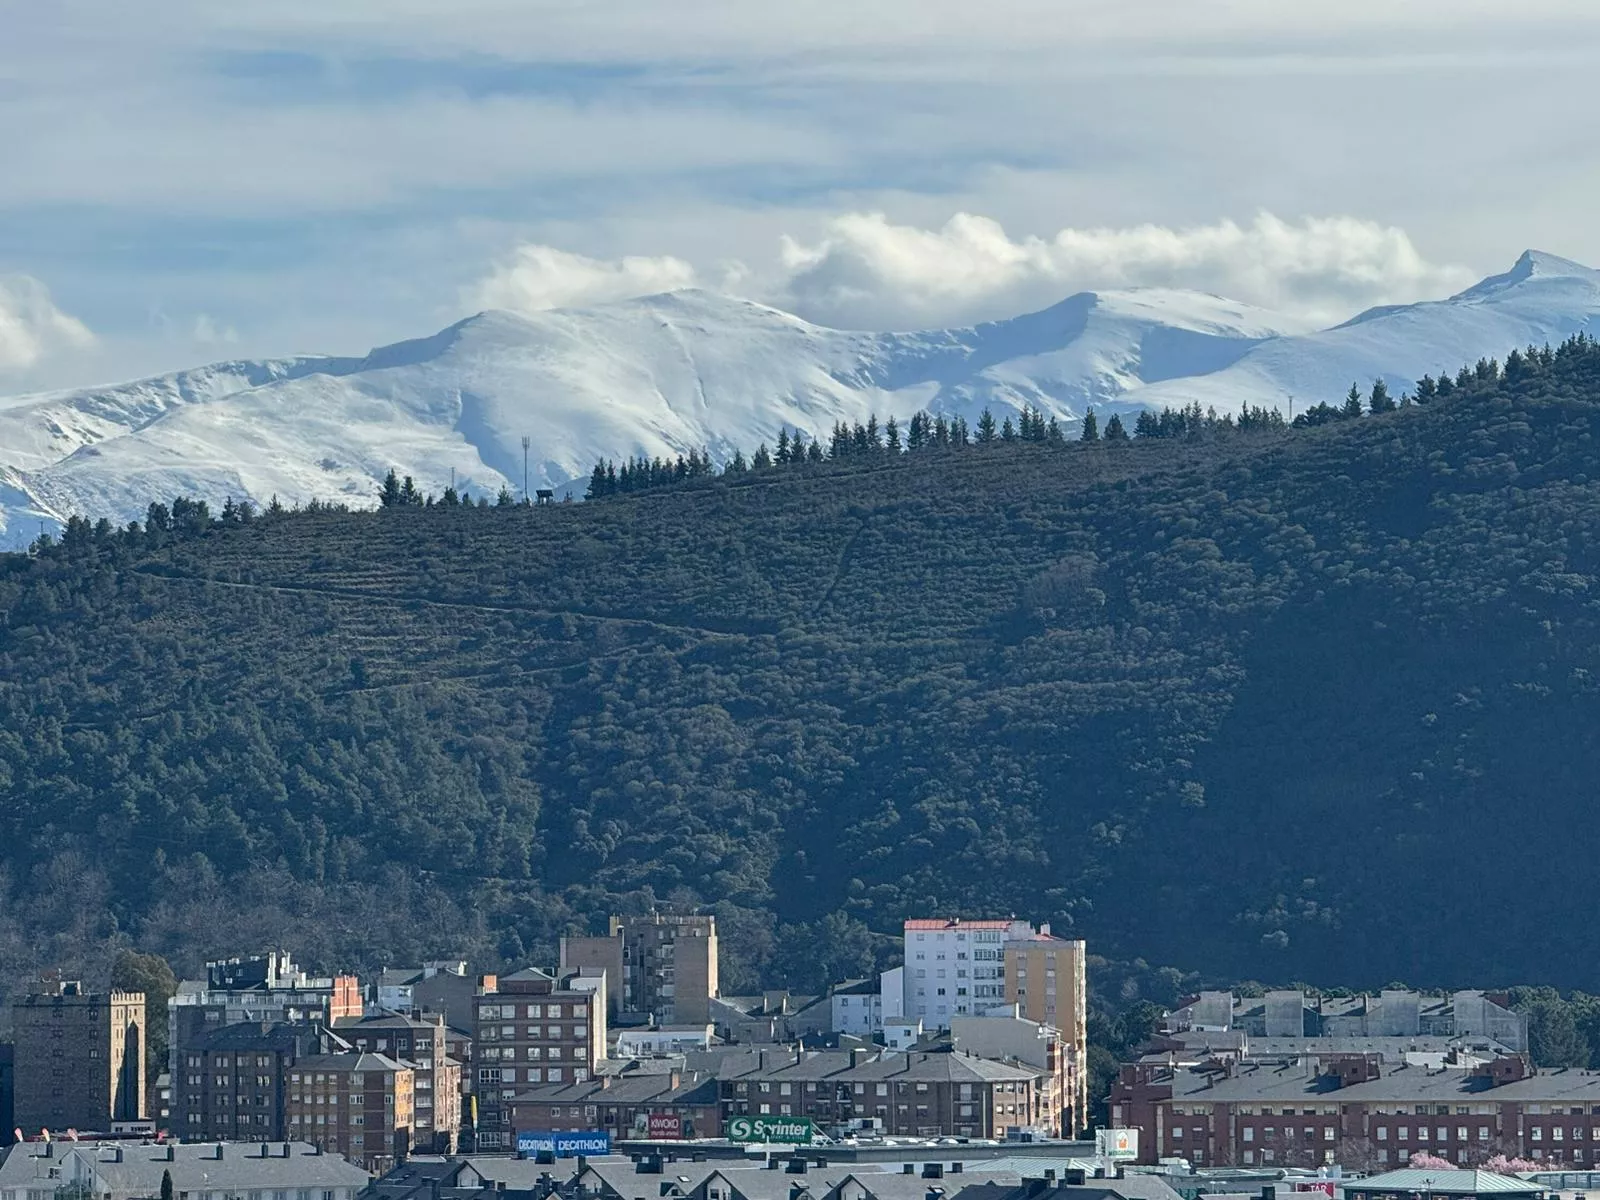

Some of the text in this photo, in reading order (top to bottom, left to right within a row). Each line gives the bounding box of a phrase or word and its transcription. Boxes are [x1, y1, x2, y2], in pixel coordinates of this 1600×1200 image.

[753, 1120, 809, 1139] Sprinter
[518, 1139, 554, 1151] DECATHLON
[558, 1139, 607, 1151] DECATHLON
